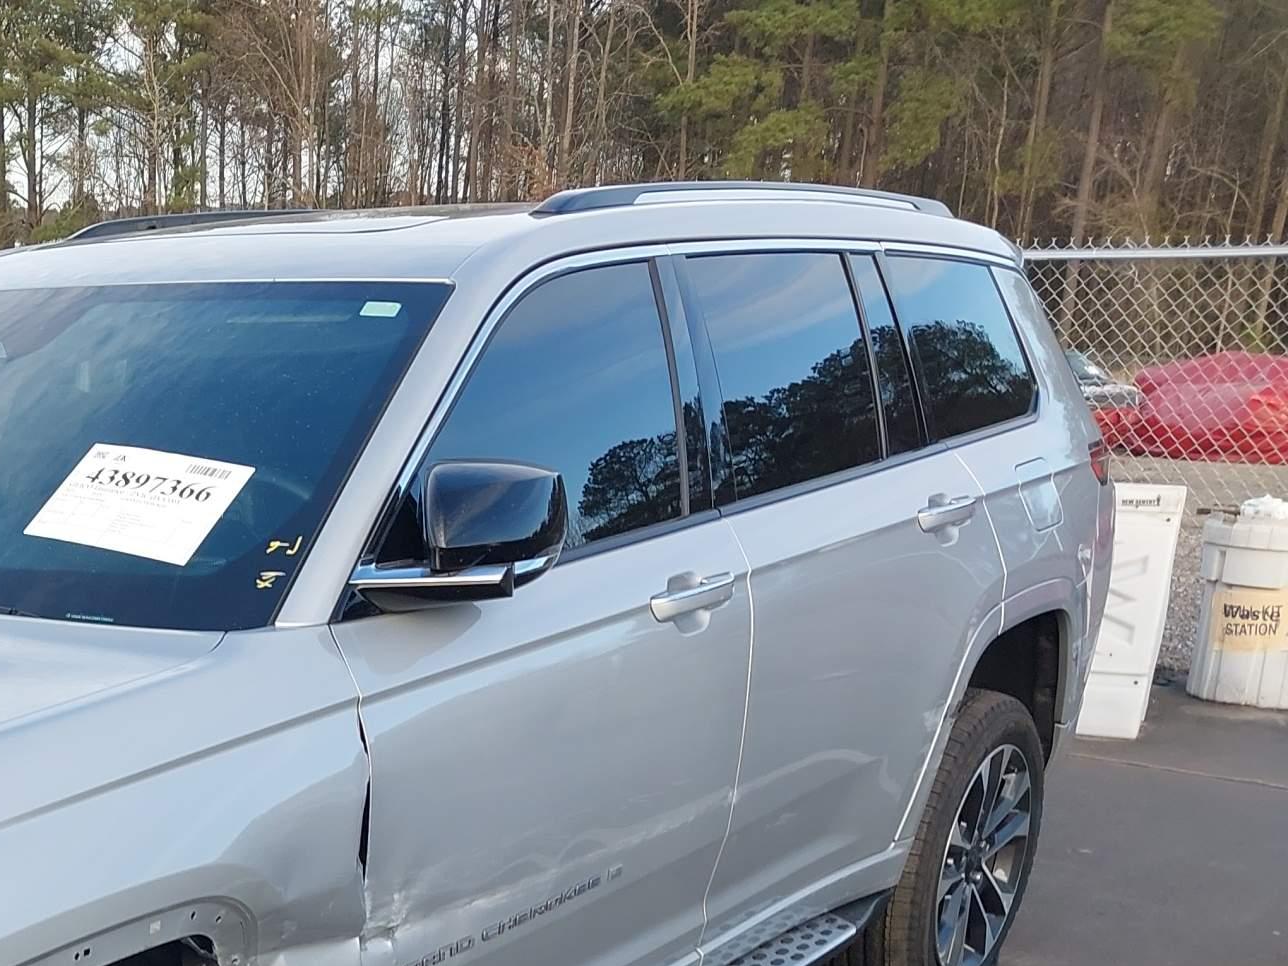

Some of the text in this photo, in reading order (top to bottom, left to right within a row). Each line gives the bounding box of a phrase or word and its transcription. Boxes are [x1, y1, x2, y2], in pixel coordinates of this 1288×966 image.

[86, 467, 217, 503] 43897366
[1224, 622, 1279, 636] STATION
[481, 875, 601, 942] CHEROKEE
